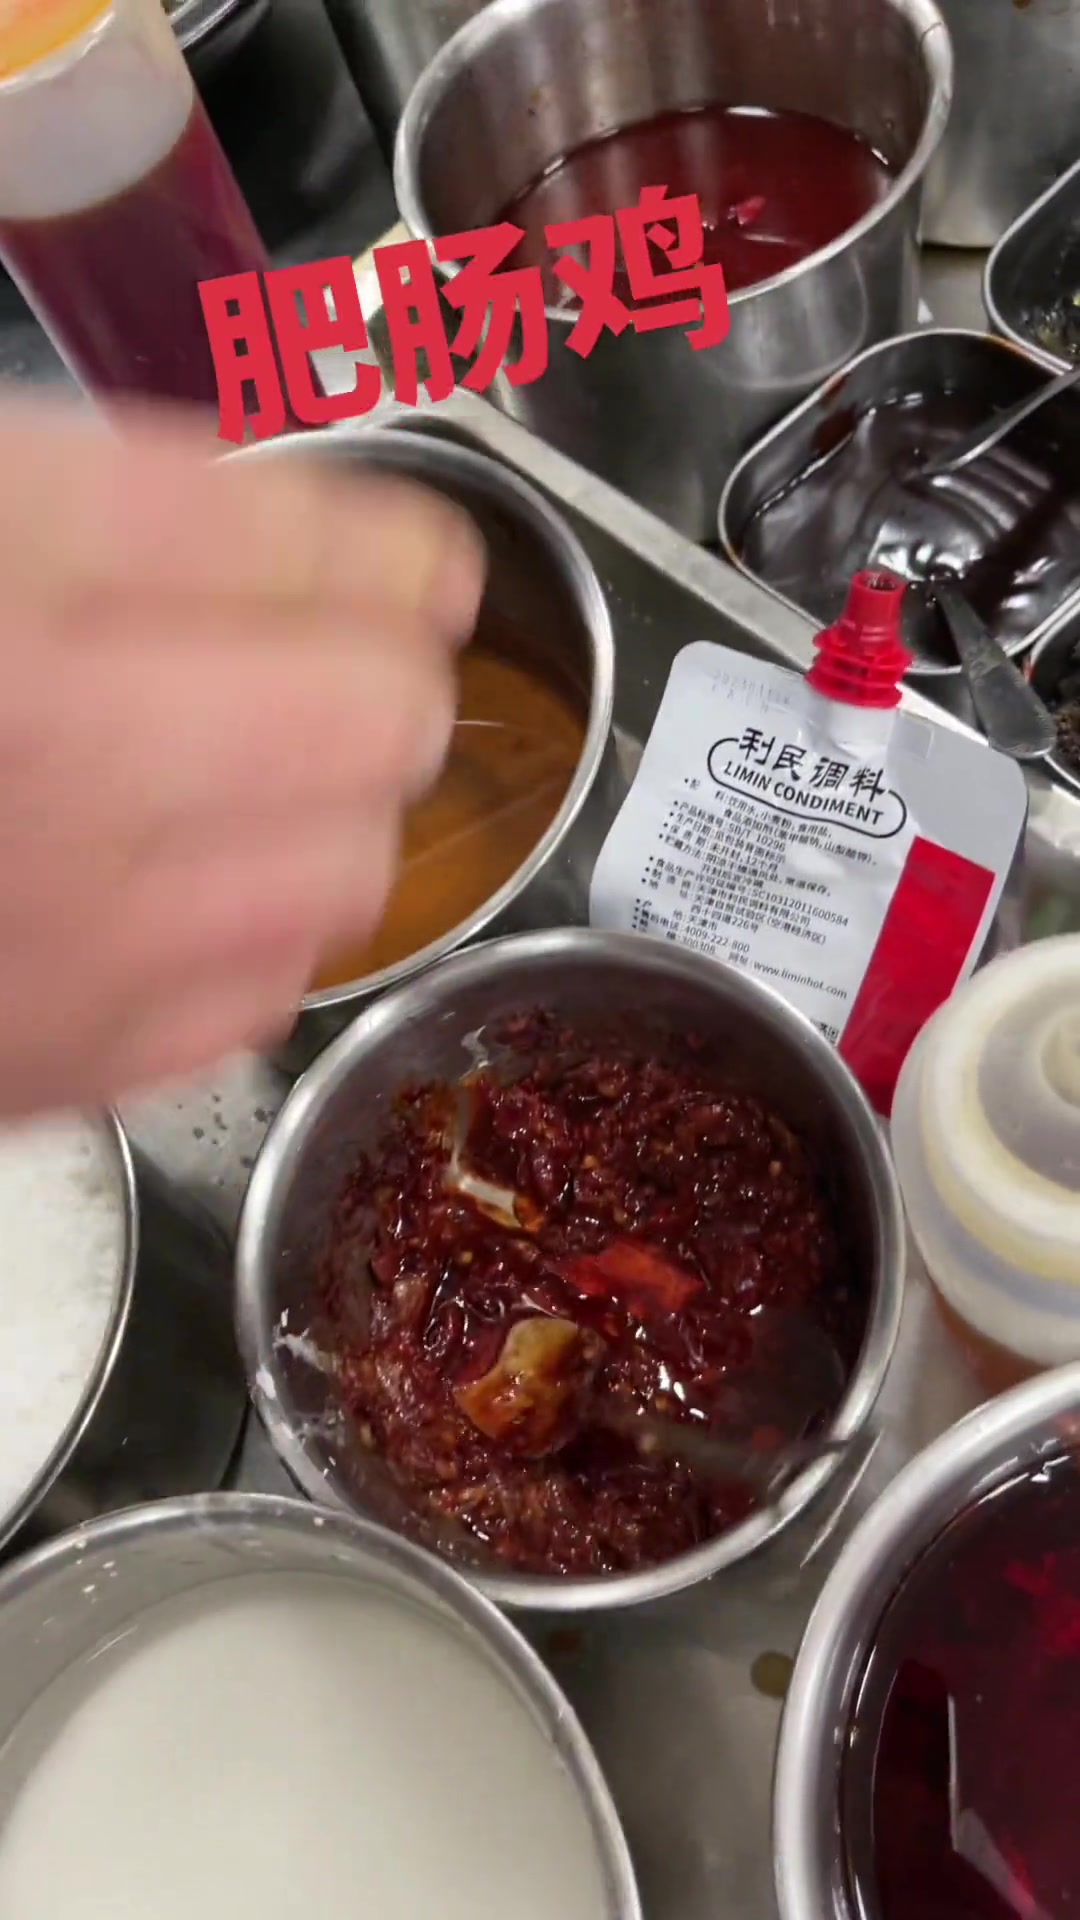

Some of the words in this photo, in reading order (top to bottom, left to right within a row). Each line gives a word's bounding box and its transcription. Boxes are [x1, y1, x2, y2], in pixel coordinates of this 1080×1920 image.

[723, 760, 773, 792] LIMIN
[773, 780, 885, 826] CONDIMENT
[739, 727, 886, 803] 利民调料
[755, 834, 786, 852] 10296
